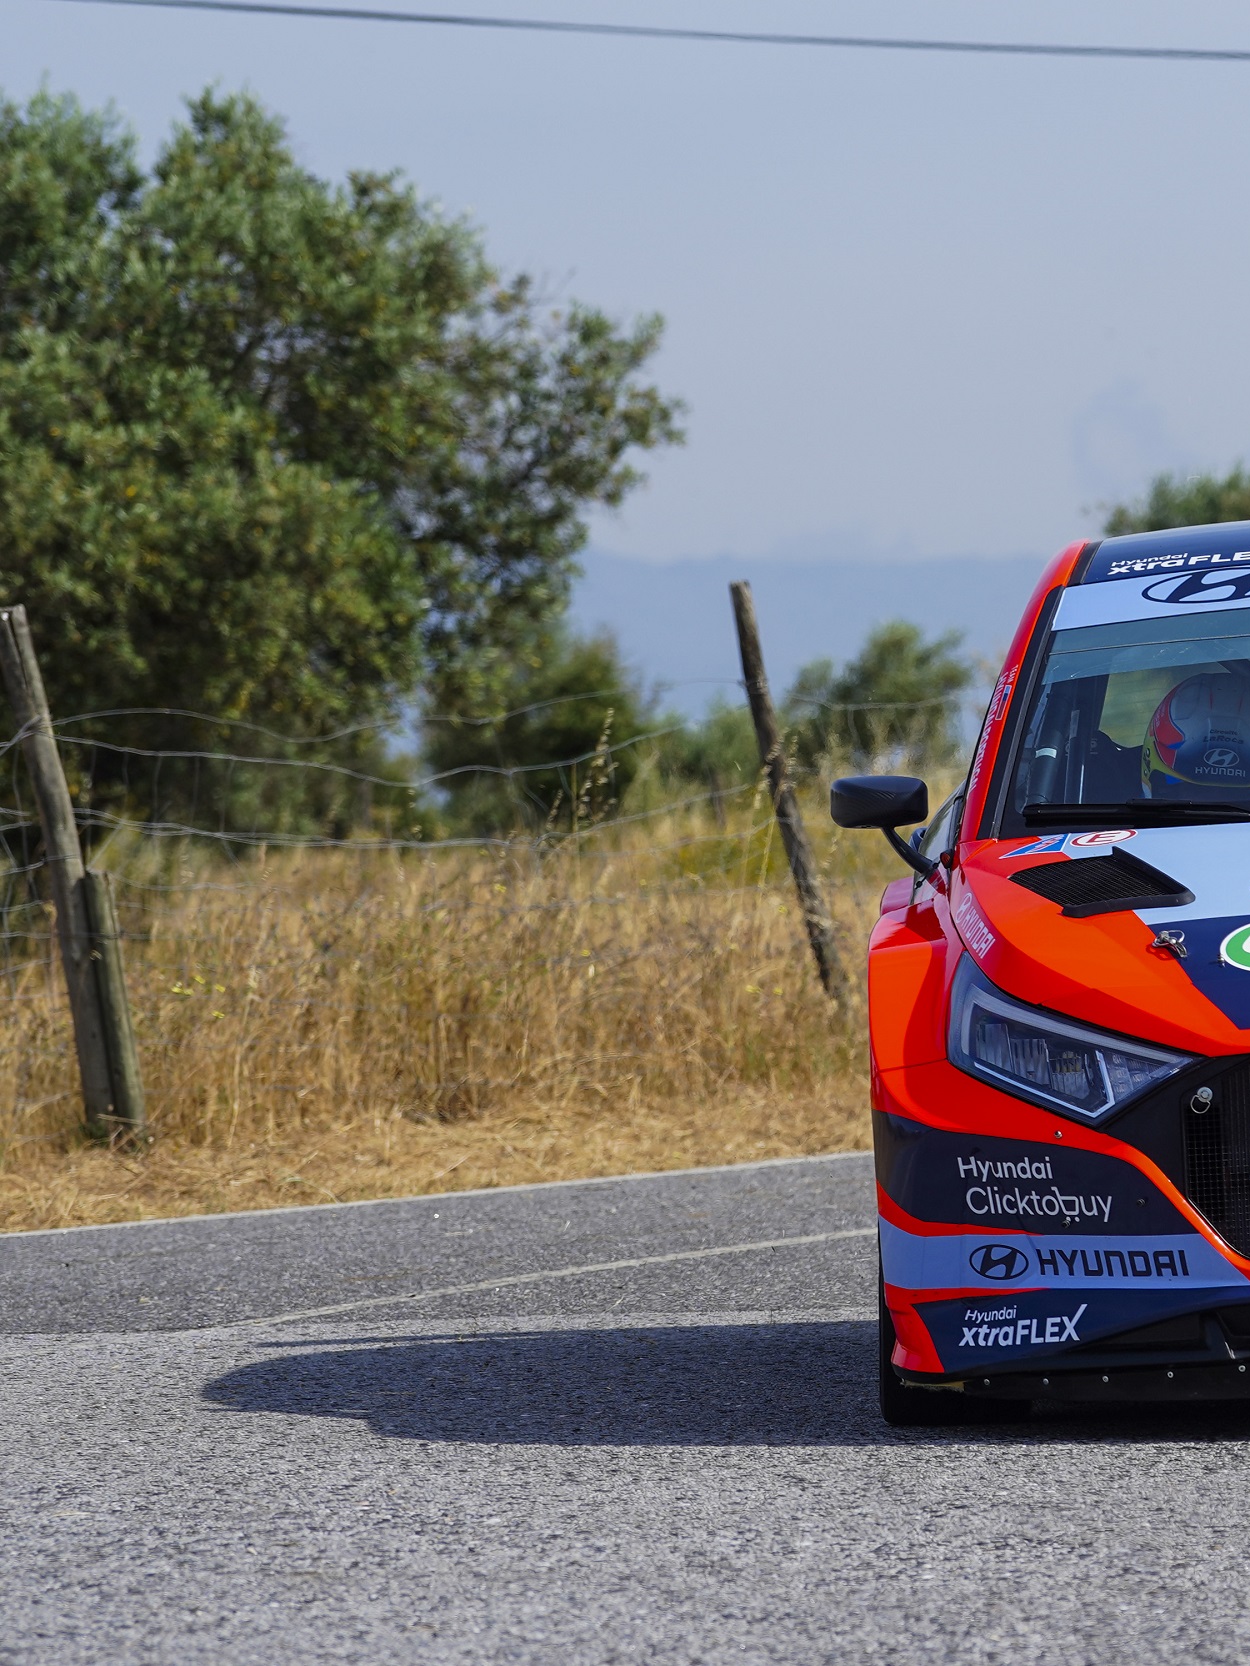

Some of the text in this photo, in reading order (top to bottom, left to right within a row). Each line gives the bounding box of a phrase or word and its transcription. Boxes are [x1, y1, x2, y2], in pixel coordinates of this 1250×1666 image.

[1111, 552, 1188, 567] Hyundai
[1195, 766, 1246, 777] HYUNDAI
[961, 906, 996, 959] HYUNDAI
[957, 1156, 1053, 1182] Hyundai
[965, 1186, 1113, 1223] Clicktobuy
[1035, 1249, 1190, 1277] HYUNDAI
[958, 1304, 1088, 1347] xtraFLEX
[965, 1305, 1017, 1323] Hyundai
